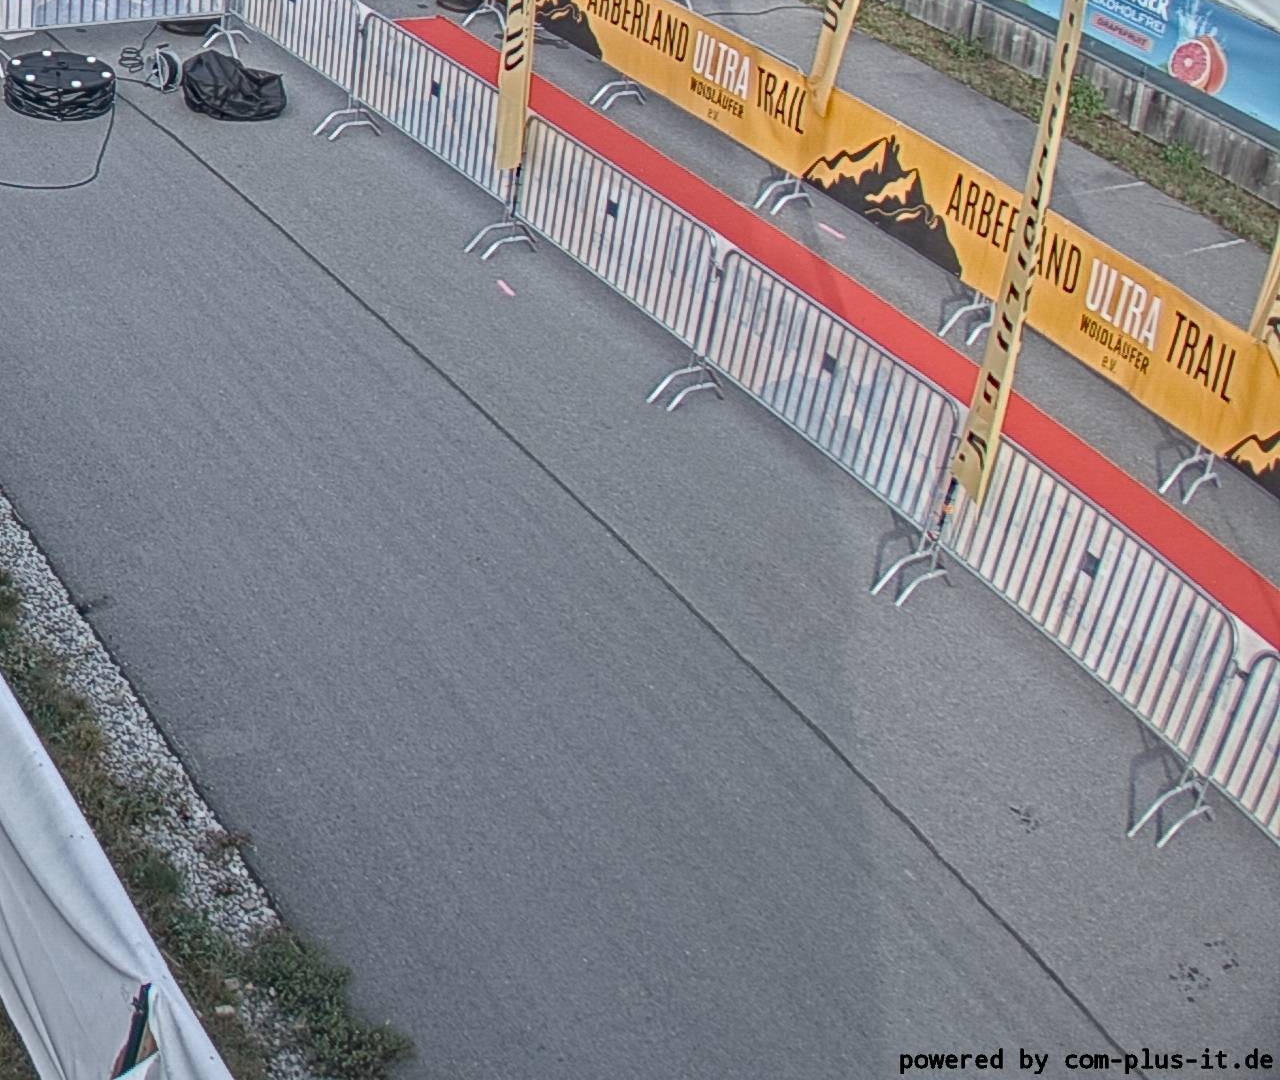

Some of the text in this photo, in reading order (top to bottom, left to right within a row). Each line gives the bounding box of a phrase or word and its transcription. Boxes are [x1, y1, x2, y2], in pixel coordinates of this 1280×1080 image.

[692, 30, 751, 101] ULTRA
[755, 66, 808, 135] TRAIL
[945, 172, 1237, 404] ARBERAND ULTRA TRAIL
[1079, 314, 1151, 376] WOIDLÄUFER
